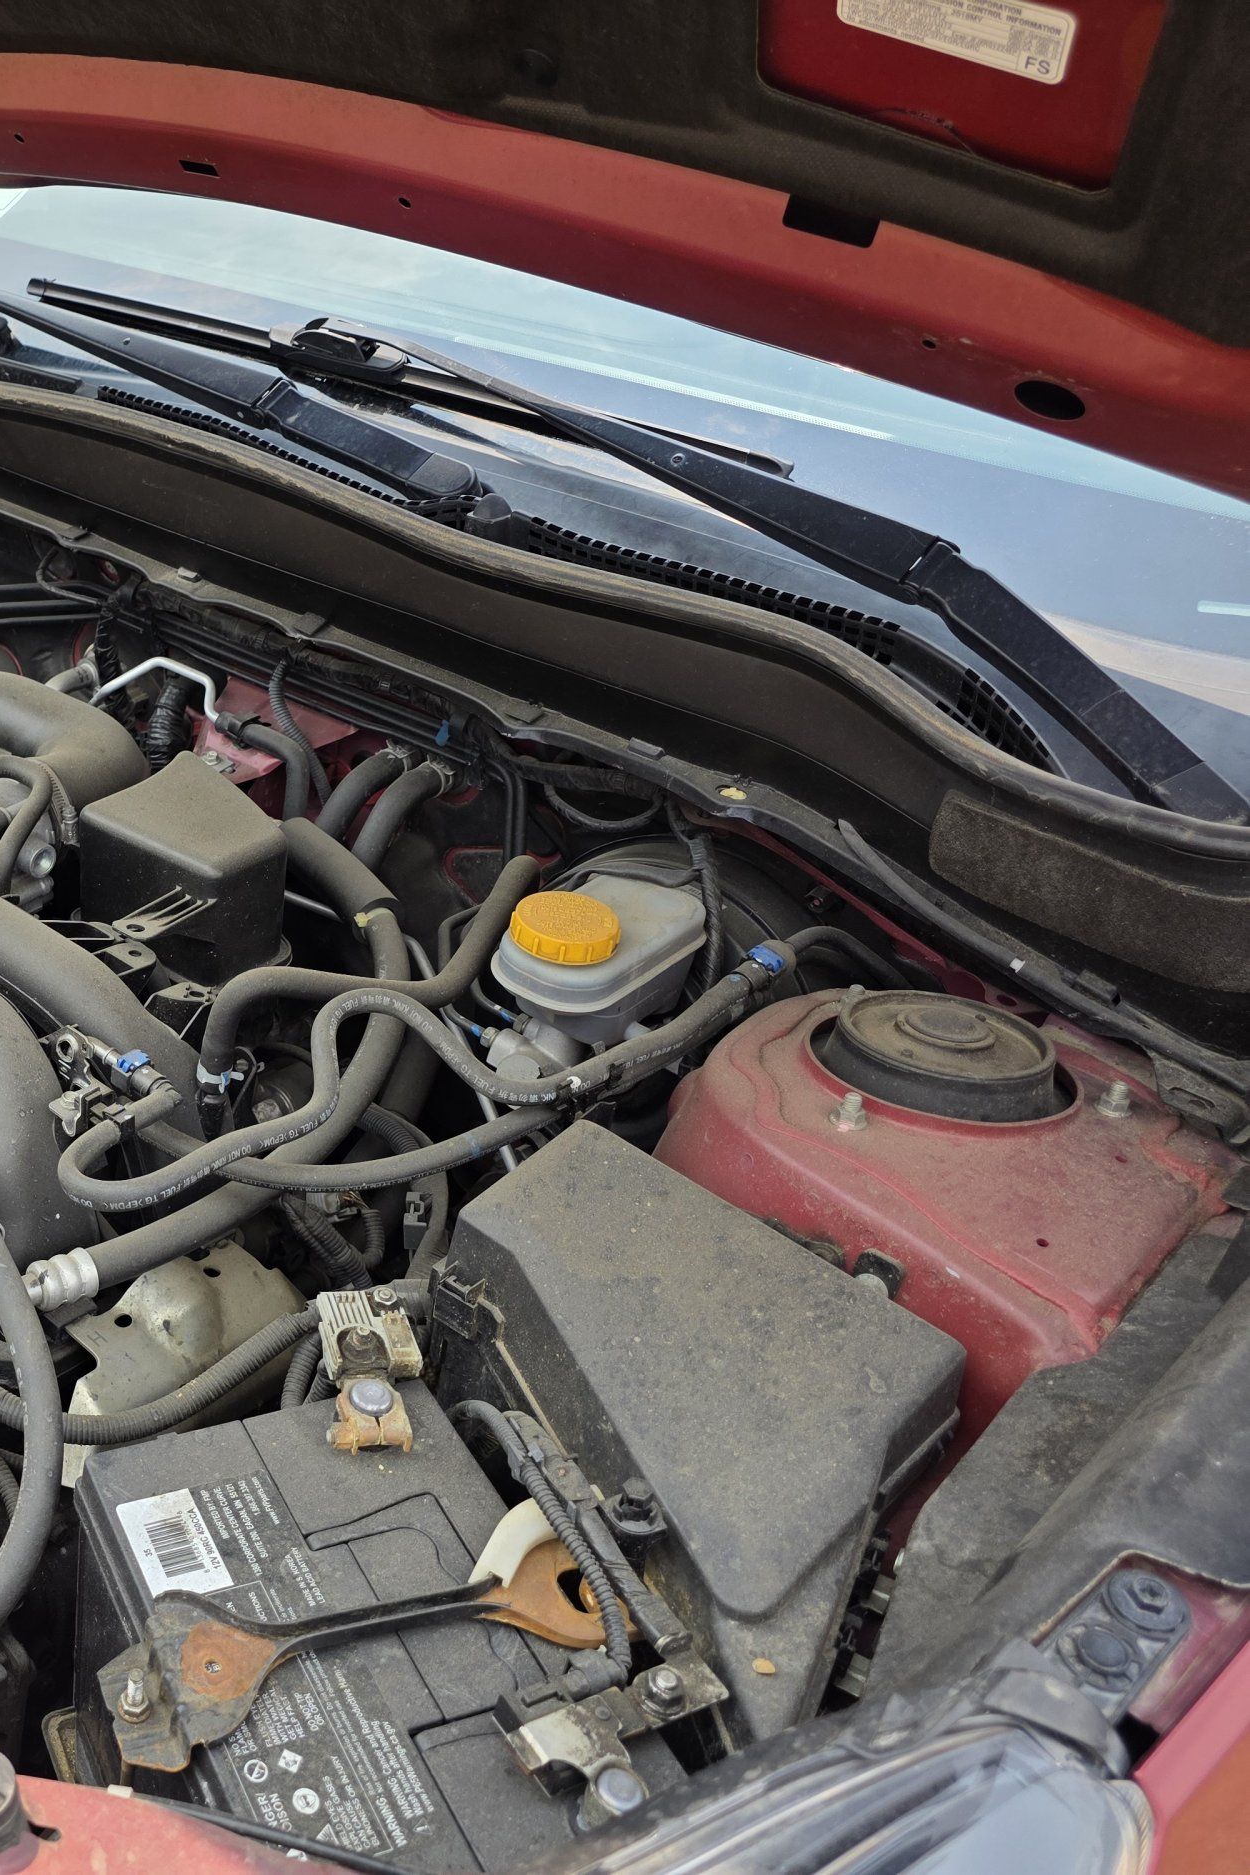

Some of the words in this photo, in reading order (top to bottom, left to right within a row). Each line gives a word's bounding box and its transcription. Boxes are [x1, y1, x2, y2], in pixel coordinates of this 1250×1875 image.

[1006, 15, 1062, 36] INFORMATION
[1024, 56, 1051, 75] FS
[458, 1063, 473, 1077] TG
[470, 1072, 496, 1097] FUEL
[286, 1126, 300, 1140] TG
[298, 1115, 319, 1136] FUEL
[144, 1194, 158, 1204] TG
[159, 1183, 182, 1199] FUEL
[185, 1507, 207, 1535] 450CCA
[209, 1509, 231, 1539] IMPORTED
[221, 1505, 240, 1528] CENTER
[142, 1548, 153, 1557] 35
[199, 1535, 216, 1554] 90RC
[232, 1527, 257, 1563] CORPORATE
[253, 1540, 269, 1558] SUITE
[208, 1554, 223, 1569] 12V
[283, 1553, 300, 1574] KOREA
[289, 1545, 309, 1572] BATTERY
[304, 1572, 317, 1587] ACID
[301, 1588, 316, 1606] MADE
[311, 1586, 326, 1603] LEAD
[266, 1686, 291, 1722] MEDICAL
[292, 1690, 305, 1703] TIP
[298, 1703, 313, 1719] NOT
[313, 1712, 326, 1725] OR
[341, 1687, 373, 1734] Reproductive
[254, 1720, 274, 1747] FLUSH
[274, 1721, 290, 1743] WITH
[284, 1722, 298, 1740] GET
[289, 1715, 306, 1738] HELP
[306, 1719, 319, 1731] DO
[230, 1742, 243, 1756] NO
[246, 1738, 258, 1751] OR
[340, 1734, 361, 1762] explosion
[364, 1733, 379, 1748] and
[329, 1754, 350, 1783] INJURY
[371, 1747, 393, 1775] Cancer
[384, 1750, 401, 1769] after
[320, 1774, 342, 1804] GASES
[343, 1783, 357, 1797] OR
[393, 1768, 413, 1793] hands
[385, 1774, 415, 1819] WARNING:
[405, 1792, 425, 1816] Wash
[253, 1790, 281, 1828] NGER/
[266, 1792, 295, 1832] OISON
[342, 1799, 363, 1828] CAUSE
[334, 1804, 364, 1851] EXPLOSIVE
[350, 1797, 381, 1846] BLINDNESS
[372, 1793, 408, 1847] WARNING:
[356, 1829, 372, 1848] CAN
